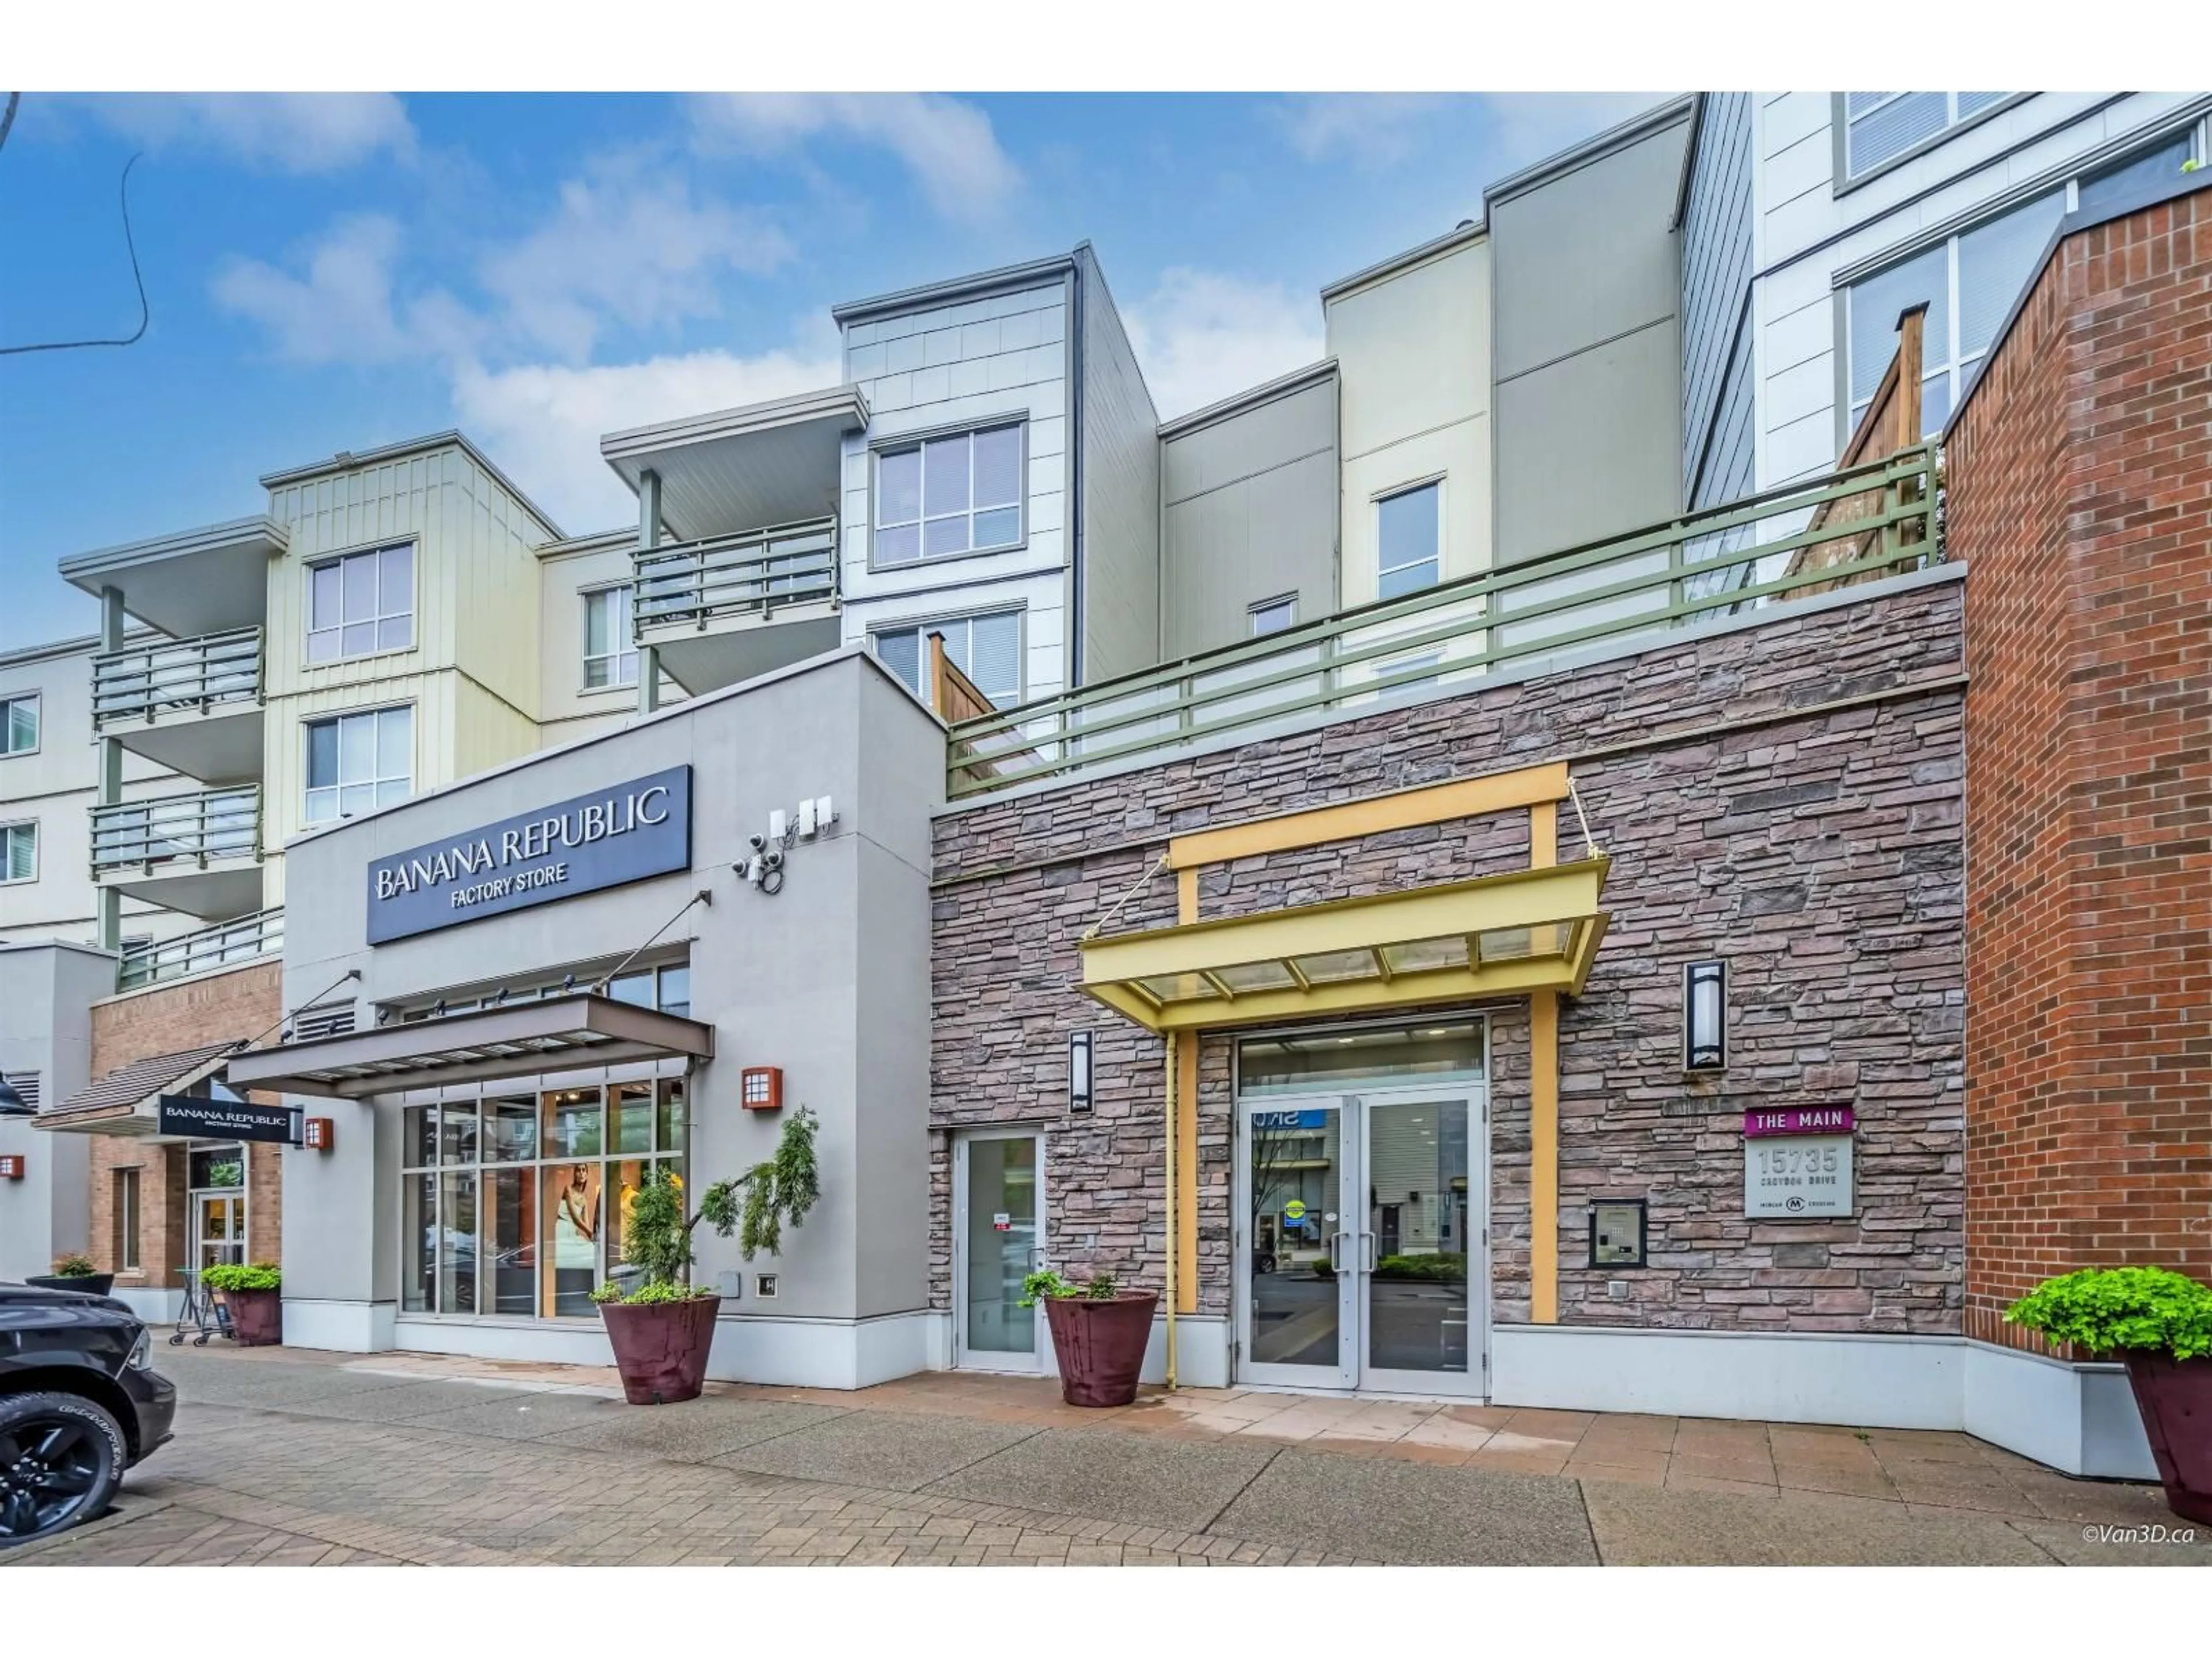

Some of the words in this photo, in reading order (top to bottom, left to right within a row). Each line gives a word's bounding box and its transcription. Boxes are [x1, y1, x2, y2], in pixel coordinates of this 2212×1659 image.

[377, 839, 494, 900] BANANA
[502, 786, 669, 865] REPUBLIC
[451, 876, 514, 908] FACTORY
[516, 863, 569, 892] STORE
[166, 1107, 224, 1121] BANANA
[226, 1113, 287, 1127] REPUBLIC
[1756, 1115, 1786, 1129] THE
[1799, 1111, 1842, 1127] MAIN
[1758, 1147, 1838, 1174] 15735
[1808, 1176, 1836, 1185] DRIVE
